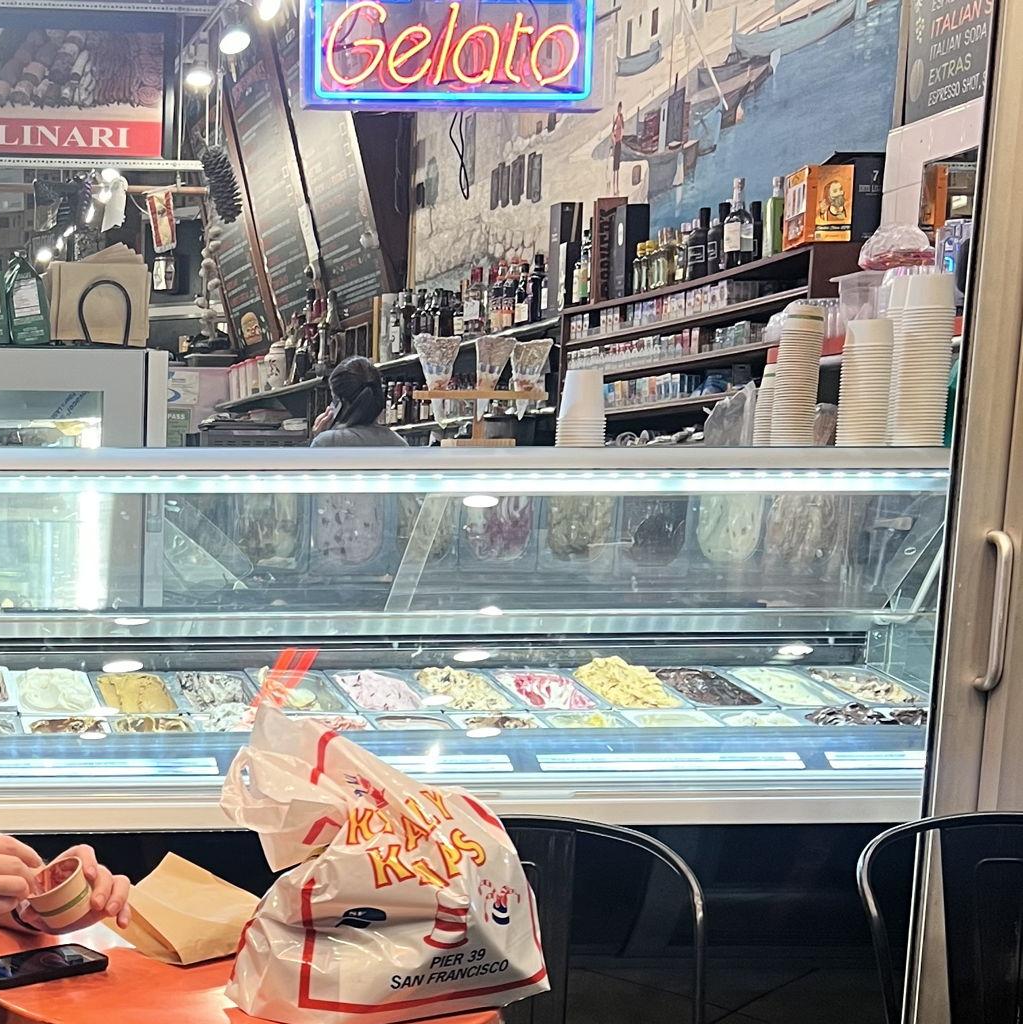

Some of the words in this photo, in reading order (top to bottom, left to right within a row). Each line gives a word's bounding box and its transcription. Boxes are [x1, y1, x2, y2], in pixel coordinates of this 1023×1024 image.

[931, 0, 981, 39] ITALIAN
[327, 1, 580, 86] Gelato
[930, 33, 961, 61] ITALIAN
[964, 22, 987, 45] SODA
[928, 53, 972, 87] EXTRAS
[928, 81, 960, 107] ESPRESSO
[346, 790, 454, 852] KAY
[390, 975, 425, 990] SAN
[426, 959, 509, 985] FRANCISCO
[430, 953, 465, 969] PIER
[467, 949, 486, 963] 39
